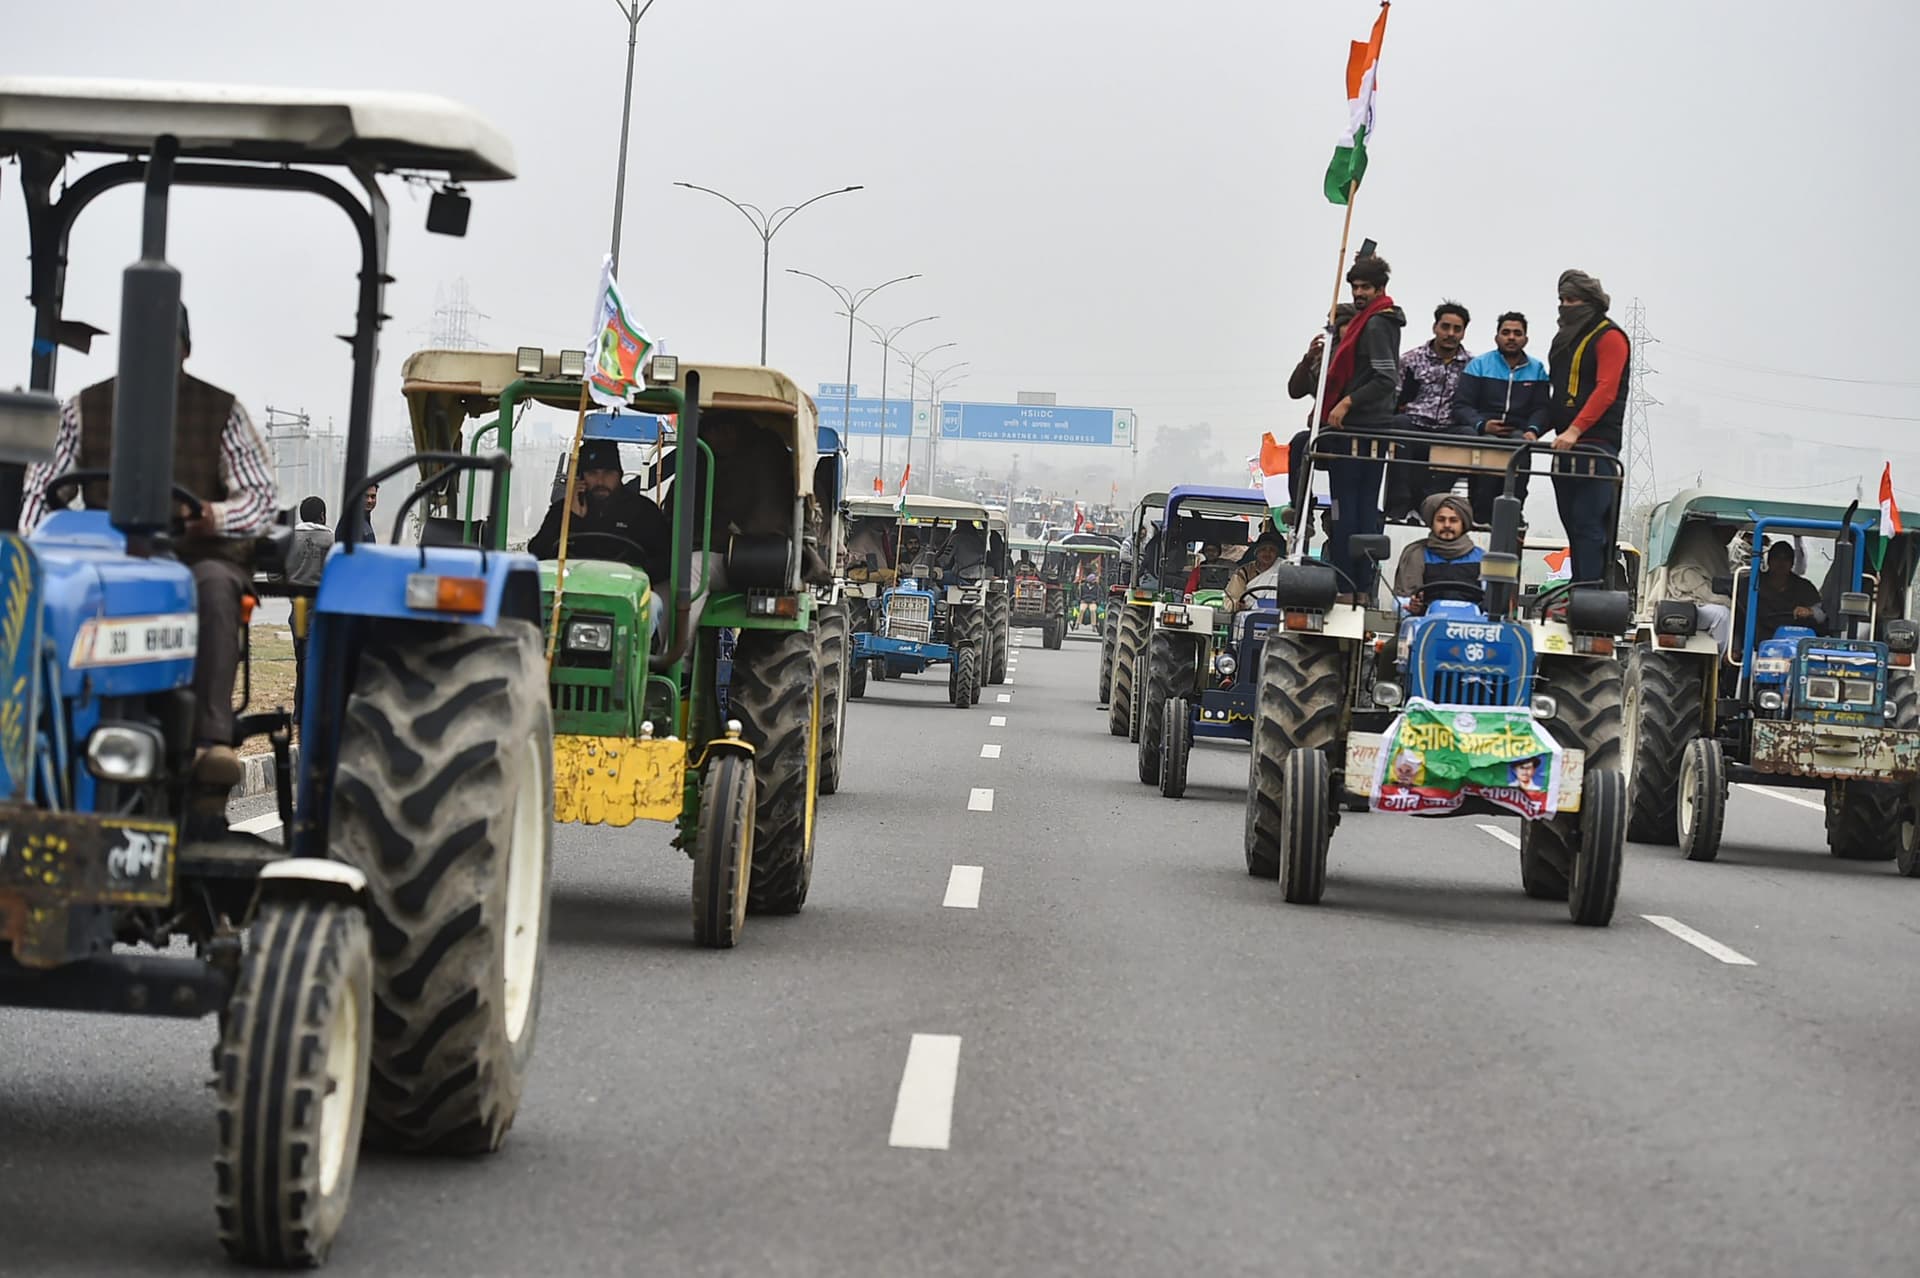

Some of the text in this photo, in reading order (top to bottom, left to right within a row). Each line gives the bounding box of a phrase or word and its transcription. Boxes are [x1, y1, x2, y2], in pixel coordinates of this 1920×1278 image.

[1020, 409, 1054, 419] HSIIDC
[1002, 432, 1037, 440] PARTNER
[1053, 434, 1096, 442] PROGRESS
